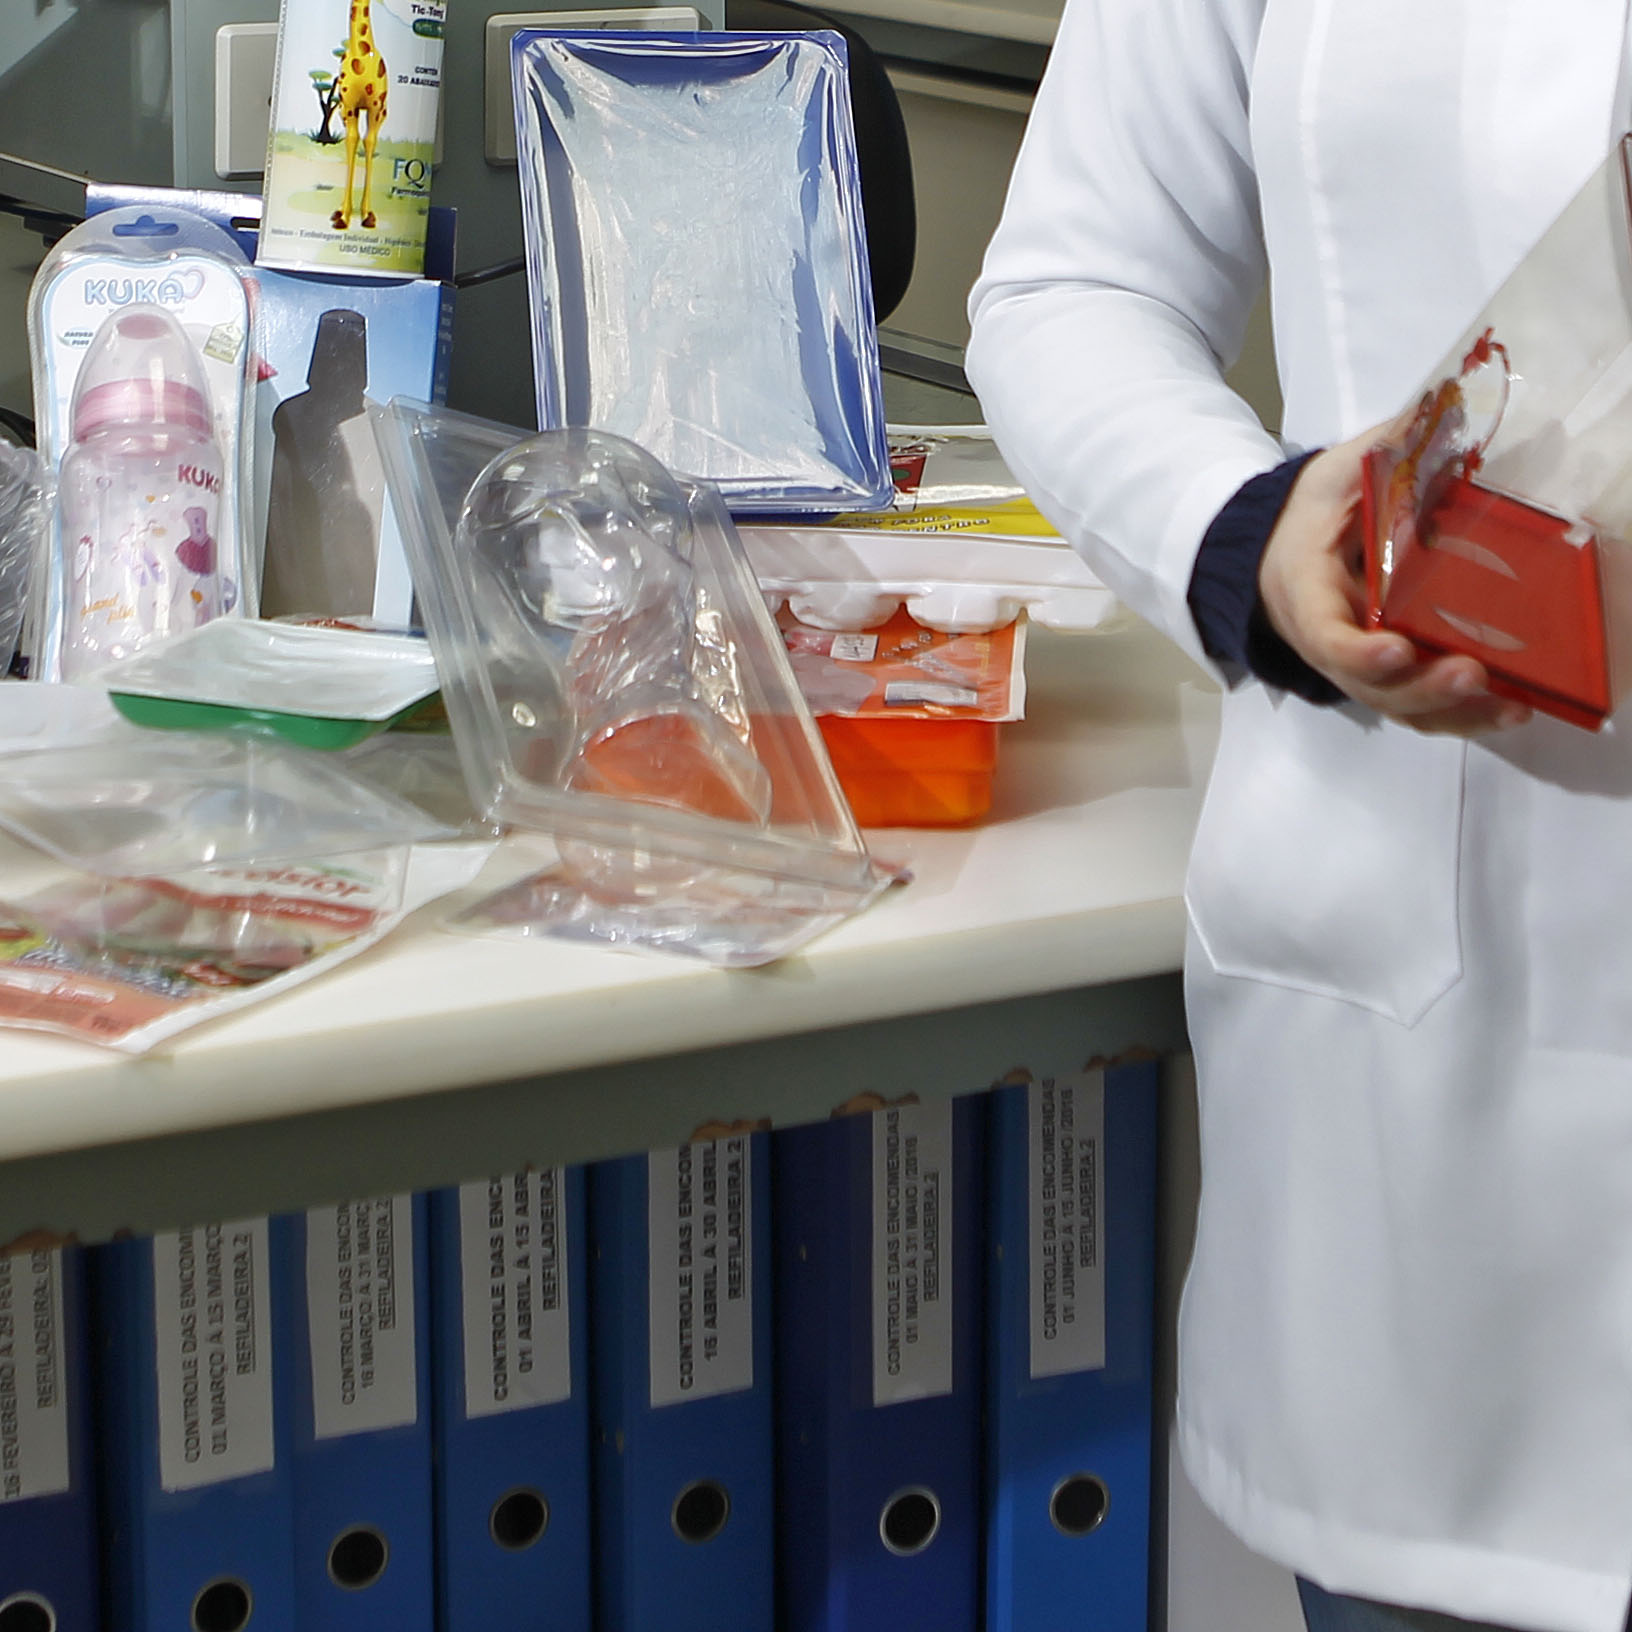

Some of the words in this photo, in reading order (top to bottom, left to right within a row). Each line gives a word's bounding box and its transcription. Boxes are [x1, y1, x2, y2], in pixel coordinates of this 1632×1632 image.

[84, 279, 184, 306] KUKA
[727, 1139, 741, 1153] 2
[1042, 1079, 1056, 1201] ENCOMENDAS
[1079, 1138, 1093, 1149] 2
[703, 1140, 716, 1209] ABRIL
[887, 1111, 900, 1235] ENCOMENDAS
[924, 1172, 936, 1182] 2
[1061, 1137, 1074, 1196] JUNHO
[376, 1199, 389, 1209] 2
[488, 1174, 504, 1229] ENC
[905, 1187, 918, 1231] MAIO
[1043, 1205, 1056, 1242] DAS
[1062, 1200, 1074, 1217] 15
[1079, 1154, 1093, 1267] REFILADEIRA
[233, 1232, 249, 1245] 2
[356, 1203, 371, 1256] MARÇ
[515, 1224, 530, 1247] 15
[540, 1169, 557, 1310] REFILADEIRA
[679, 1222, 692, 1268] DAS
[704, 1214, 716, 1239] 30
[728, 1160, 741, 1300] REFILADEIRA
[906, 1237, 918, 1253] 31
[924, 1187, 936, 1302] REFILADEIRA
[359, 1260, 371, 1278] 31
[376, 1214, 392, 1331] REFILADEIRA
[490, 1234, 505, 1280] DAS
[887, 1239, 900, 1277] DAS
[1062, 1238, 1075, 1300] JUNHO
[338, 1266, 352, 1304] DAS
[517, 1274, 532, 1341] ABRIL
[703, 1265, 717, 1329] ABRIL
[906, 1274, 918, 1322] MAIO
[1043, 1246, 1056, 1340] CONTROLE
[181, 1314, 197, 1354] DAS
[208, 1302, 224, 1326] 15
[234, 1250, 251, 1376] REFILADEIRA
[359, 1302, 375, 1367] MARÇO
[679, 1272, 693, 1391] CONTROLE
[888, 1280, 900, 1376] CONTROLE
[906, 1327, 918, 1344] 01
[1063, 1306, 1075, 1324] 01
[340, 1308, 355, 1405] CONTROLE
[491, 1284, 508, 1401] CONTROLE
[519, 1349, 532, 1374] 01
[208, 1352, 226, 1427] MARÇO
[361, 1370, 374, 1388] 16
[0, 1366, 19, 1470] FEVEREIRO
[182, 1358, 200, 1464] CONTROLE
[211, 1428, 227, 1455] 01
[4, 1475, 20, 1498] 16
